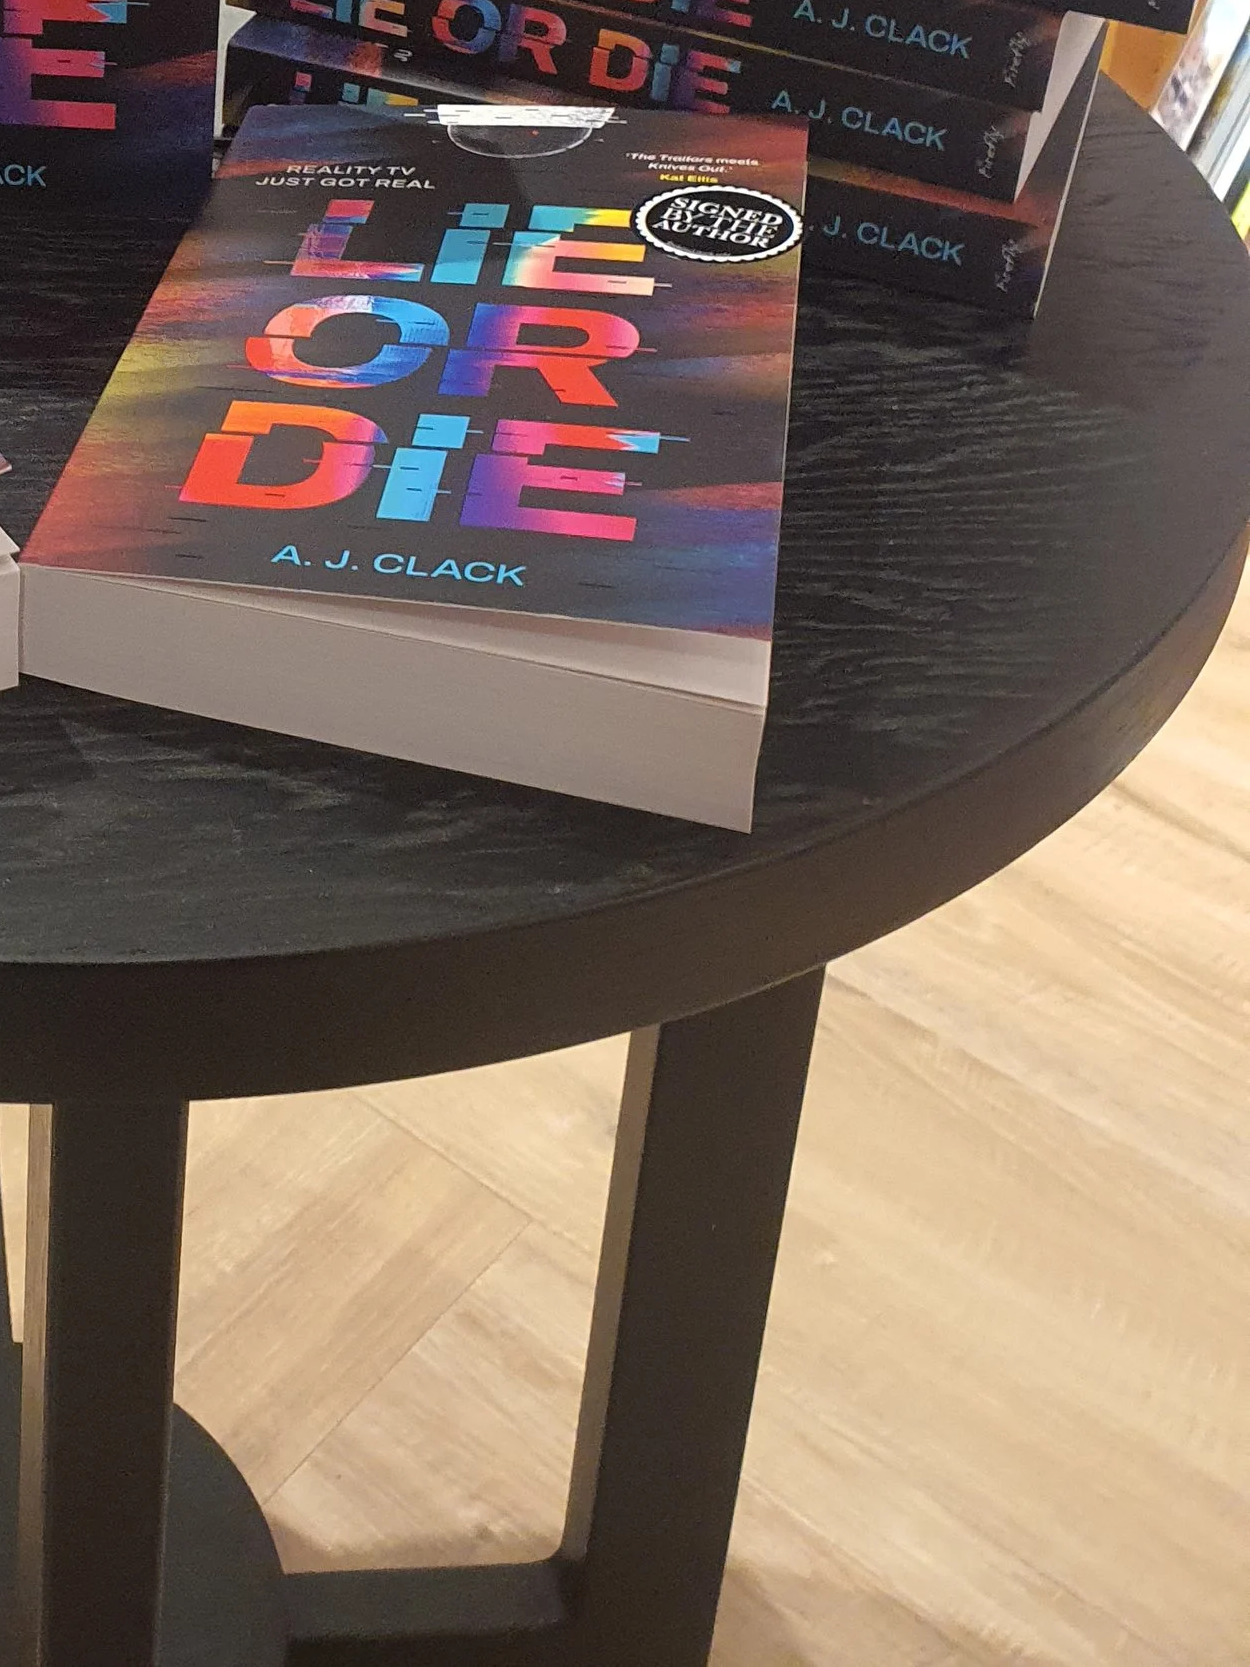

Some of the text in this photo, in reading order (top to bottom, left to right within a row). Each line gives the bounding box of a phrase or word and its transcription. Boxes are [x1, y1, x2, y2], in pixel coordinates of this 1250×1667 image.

[831, 7, 855, 31] J.
[865, 14, 974, 60] CLACK
[255, 176, 436, 189] JUST GOT REAL
[286, 165, 416, 176] REALITY TV
[661, 207, 779, 239] BY THE
[671, 197, 784, 226] SIGNED
[653, 221, 770, 249] AUTHOR
[245, 294, 641, 408] OR
[271, 544, 527, 587] A. J. CLACK
